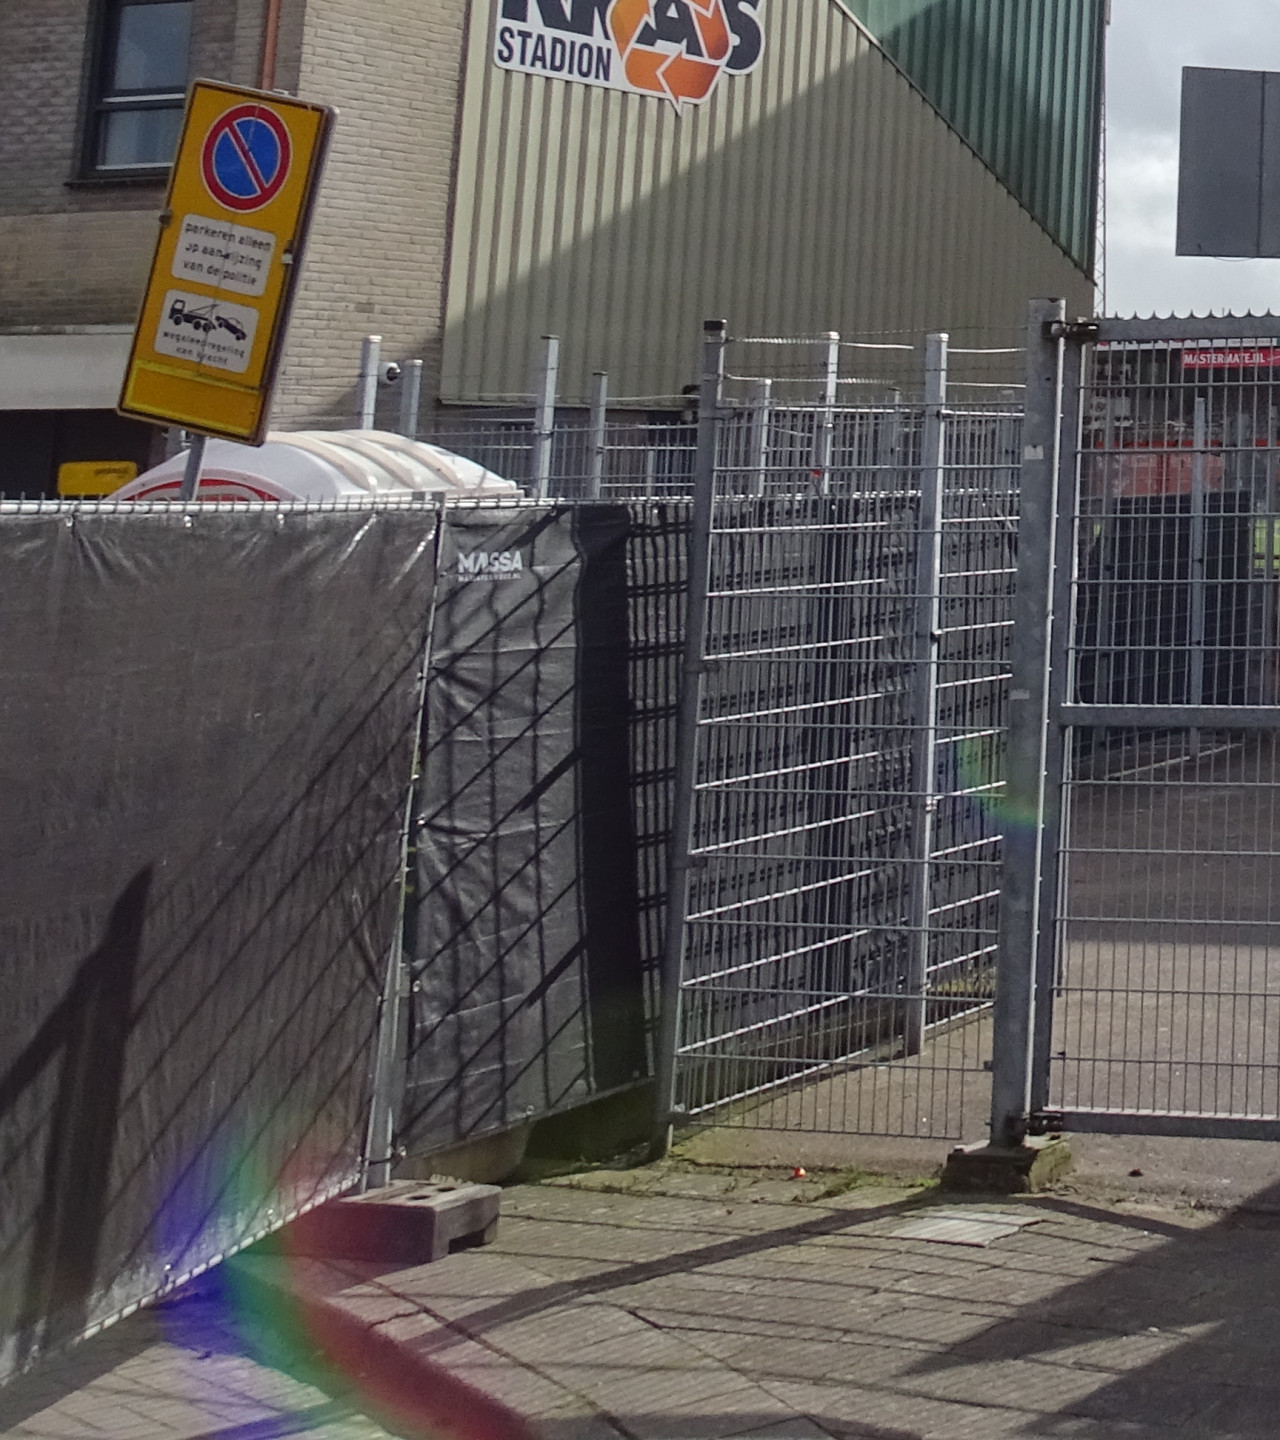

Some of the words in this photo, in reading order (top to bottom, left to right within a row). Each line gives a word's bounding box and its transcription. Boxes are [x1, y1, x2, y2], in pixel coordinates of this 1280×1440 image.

[498, 27, 612, 82] STADION
[185, 223, 236, 242] parkeren
[239, 236, 272, 251] alleen
[184, 261, 204, 273] van
[222, 270, 257, 286] politie
[458, 550, 523, 574] MASSA
